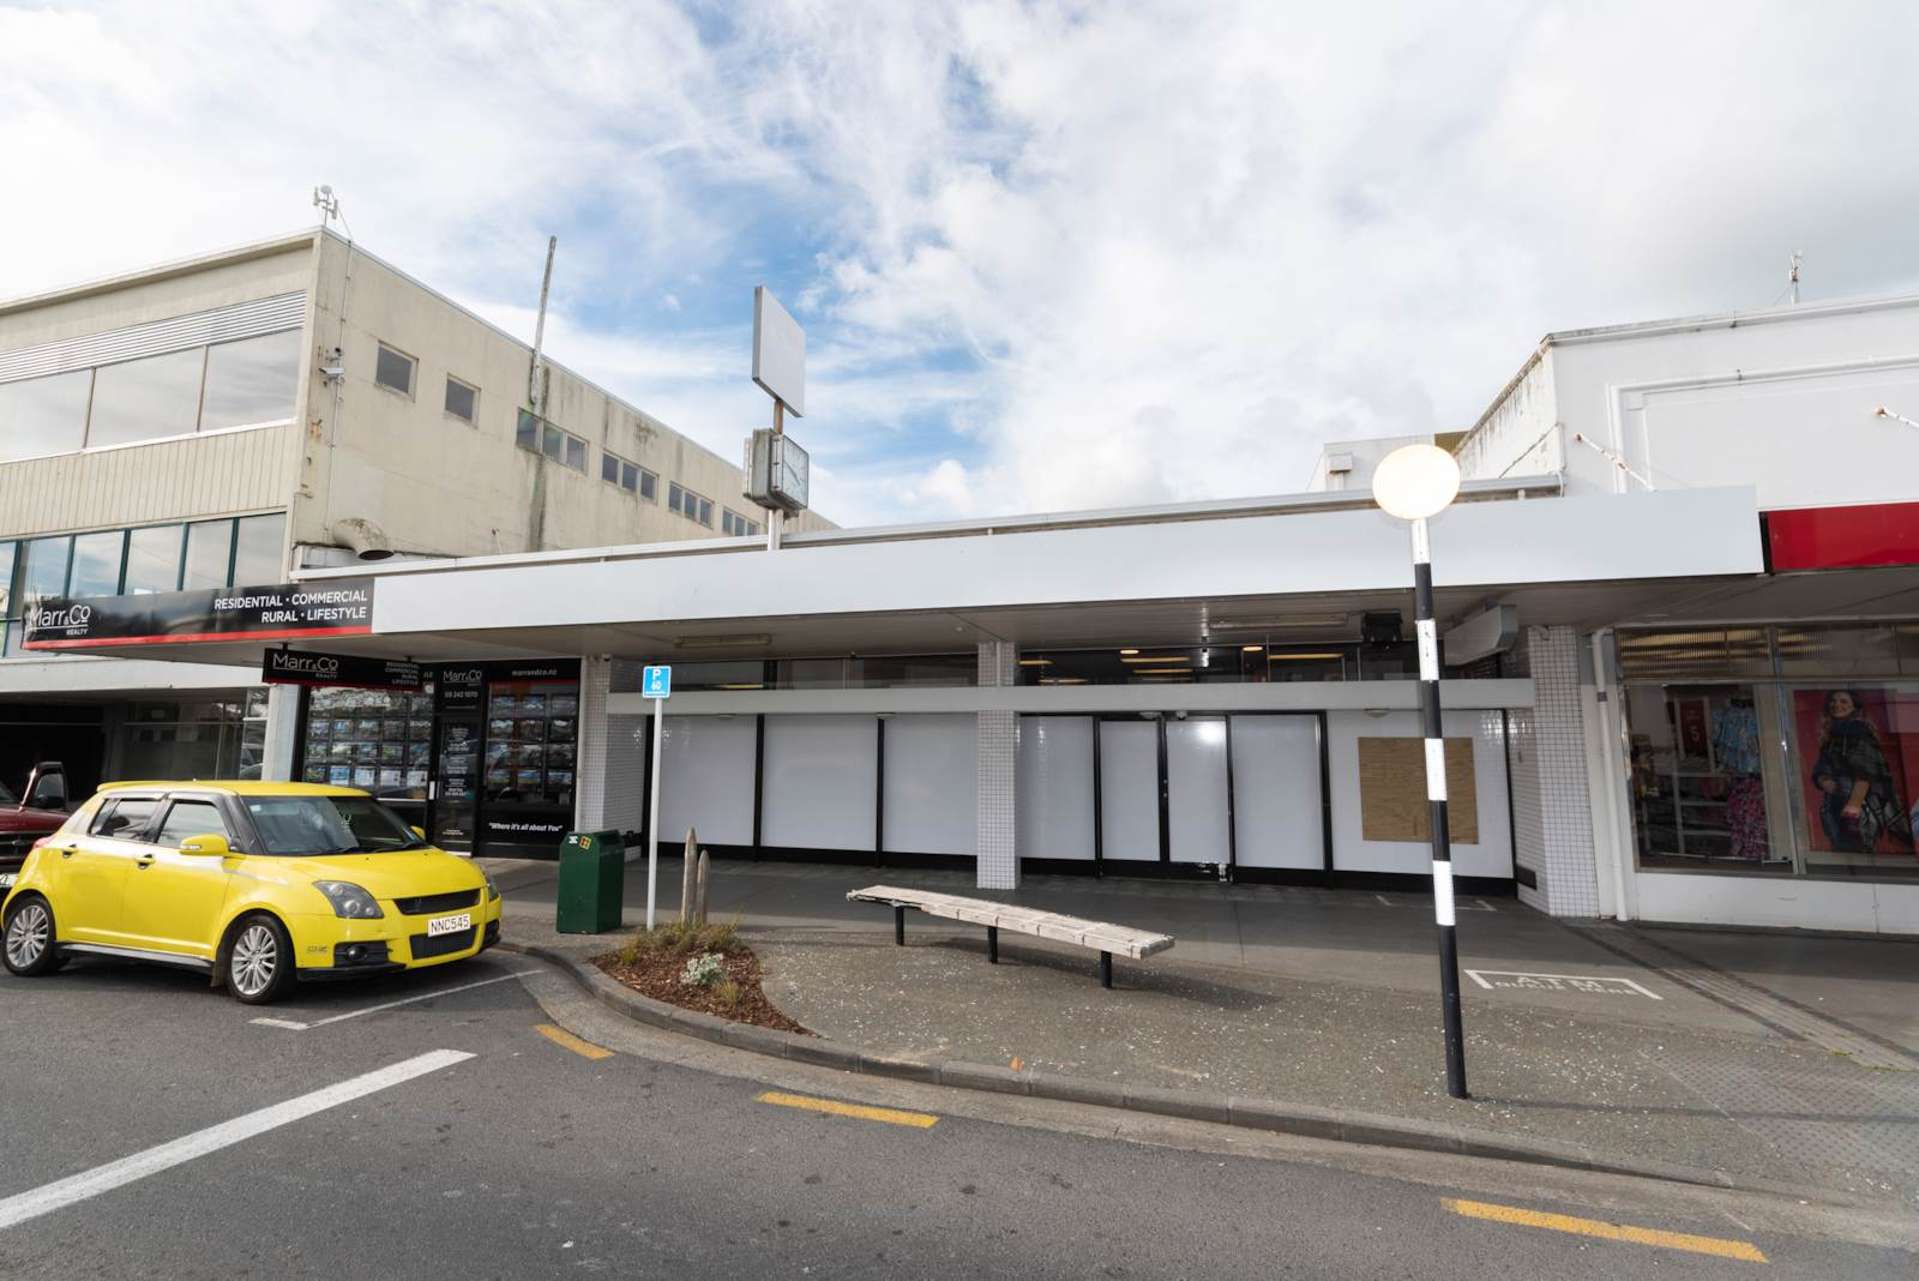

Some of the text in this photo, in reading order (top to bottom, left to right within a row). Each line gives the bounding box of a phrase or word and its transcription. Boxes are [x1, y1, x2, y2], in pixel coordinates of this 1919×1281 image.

[213, 590, 368, 610] RESIDENTIAL COMMERCIAL
[261, 606, 367, 624] RURAL LIFESTYLE
[652, 668, 662, 681] P
[431, 915, 470, 934] NNC545
